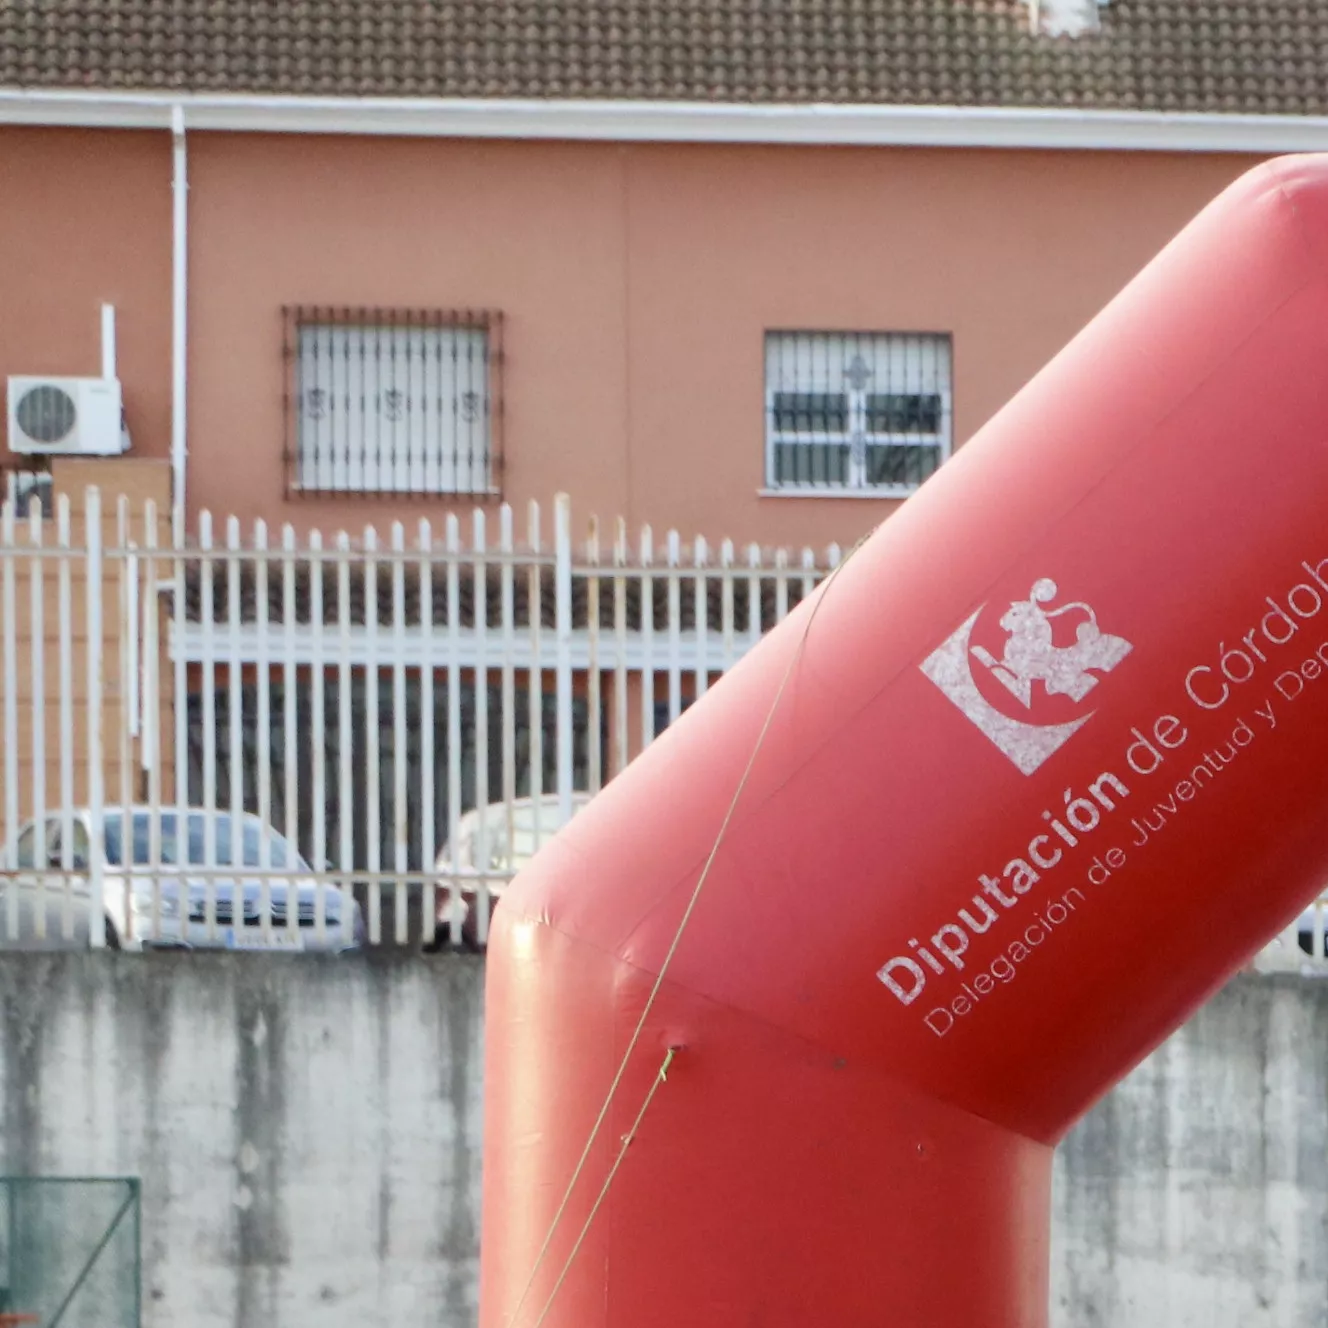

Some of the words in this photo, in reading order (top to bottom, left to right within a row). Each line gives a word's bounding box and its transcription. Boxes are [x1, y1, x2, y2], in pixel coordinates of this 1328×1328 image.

[876, 772, 1130, 1005] Diputación
[1126, 713, 1188, 775] de
[923, 884, 1086, 1038] Delegación
[1087, 846, 1127, 886] de
[1133, 716, 1256, 847] Juventud
[1254, 698, 1278, 729] y
